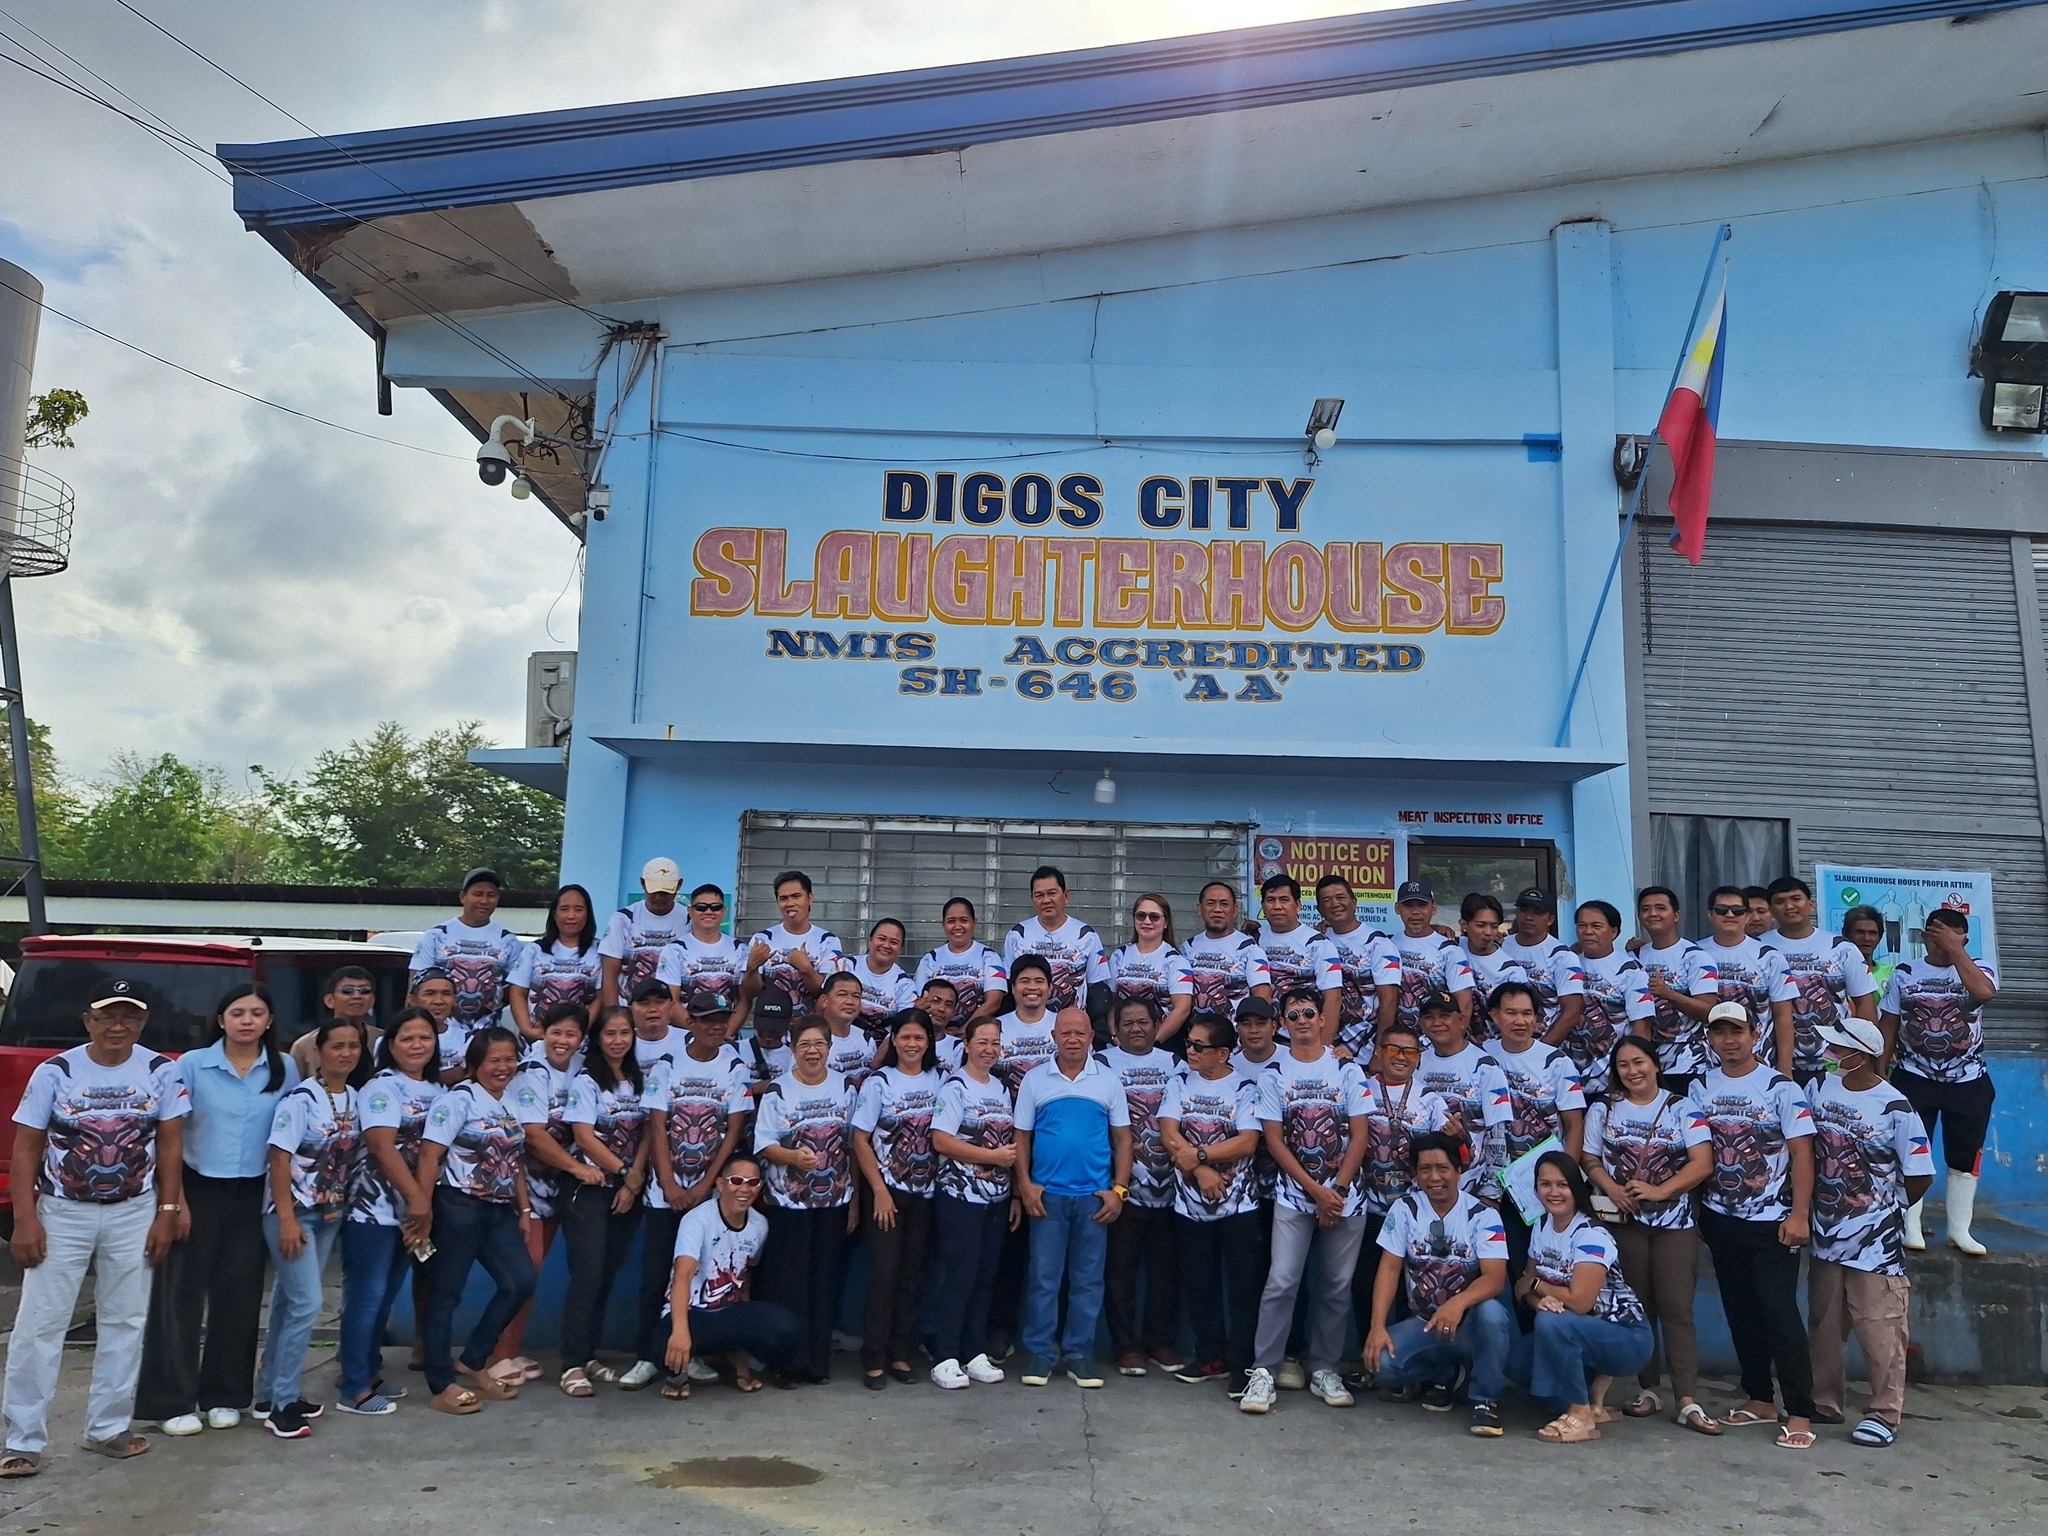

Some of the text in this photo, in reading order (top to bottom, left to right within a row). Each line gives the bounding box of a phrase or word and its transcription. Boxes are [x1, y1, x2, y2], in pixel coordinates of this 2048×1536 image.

[882, 470, 1315, 532] DIGOS CITY
[691, 526, 1506, 635] SLAUGHTERHOUSE
[765, 629, 1425, 672] NMIS ACCREDITED
[1398, 810, 1543, 825] MEAT INSPECTOR'S OFFICE
[1290, 842, 1360, 862] NOTICE
[1366, 843, 1390, 863] OF
[1286, 863, 1385, 884] VIOLATION
[1834, 874, 1974, 889] SLAUGHTERHOUSE HOUSE PROPER ATTIRE
[1359, 915, 1381, 923] ISSUED
